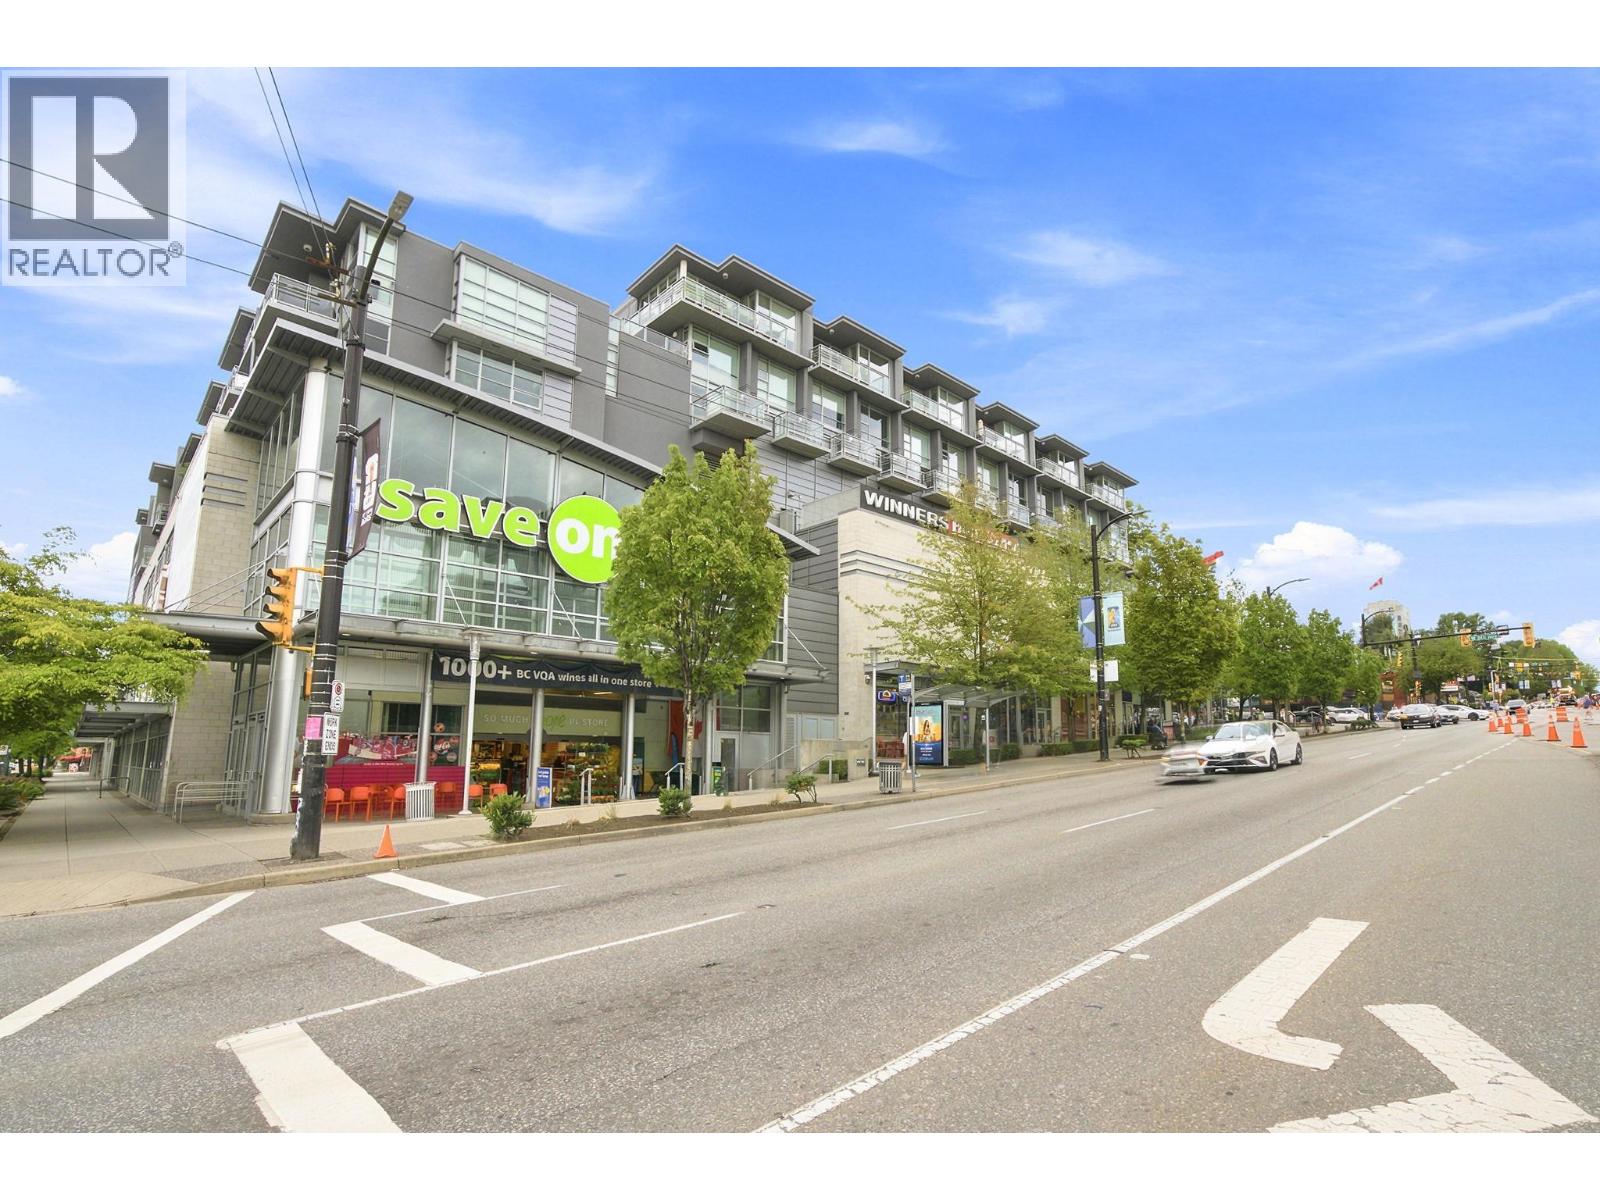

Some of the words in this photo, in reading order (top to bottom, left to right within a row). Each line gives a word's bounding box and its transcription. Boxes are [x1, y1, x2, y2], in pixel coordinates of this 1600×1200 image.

[376, 478, 541, 547] save
[864, 490, 950, 531] WINNERS
[439, 655, 512, 680] 1000+
[516, 669, 531, 679] BC
[533, 670, 556, 680] VQA
[558, 672, 586, 682] wines
[588, 673, 598, 683] all
[600, 674, 609, 684] in
[611, 677, 628, 686] one
[630, 678, 652, 688] store
[582, 718, 609, 728] STORE
